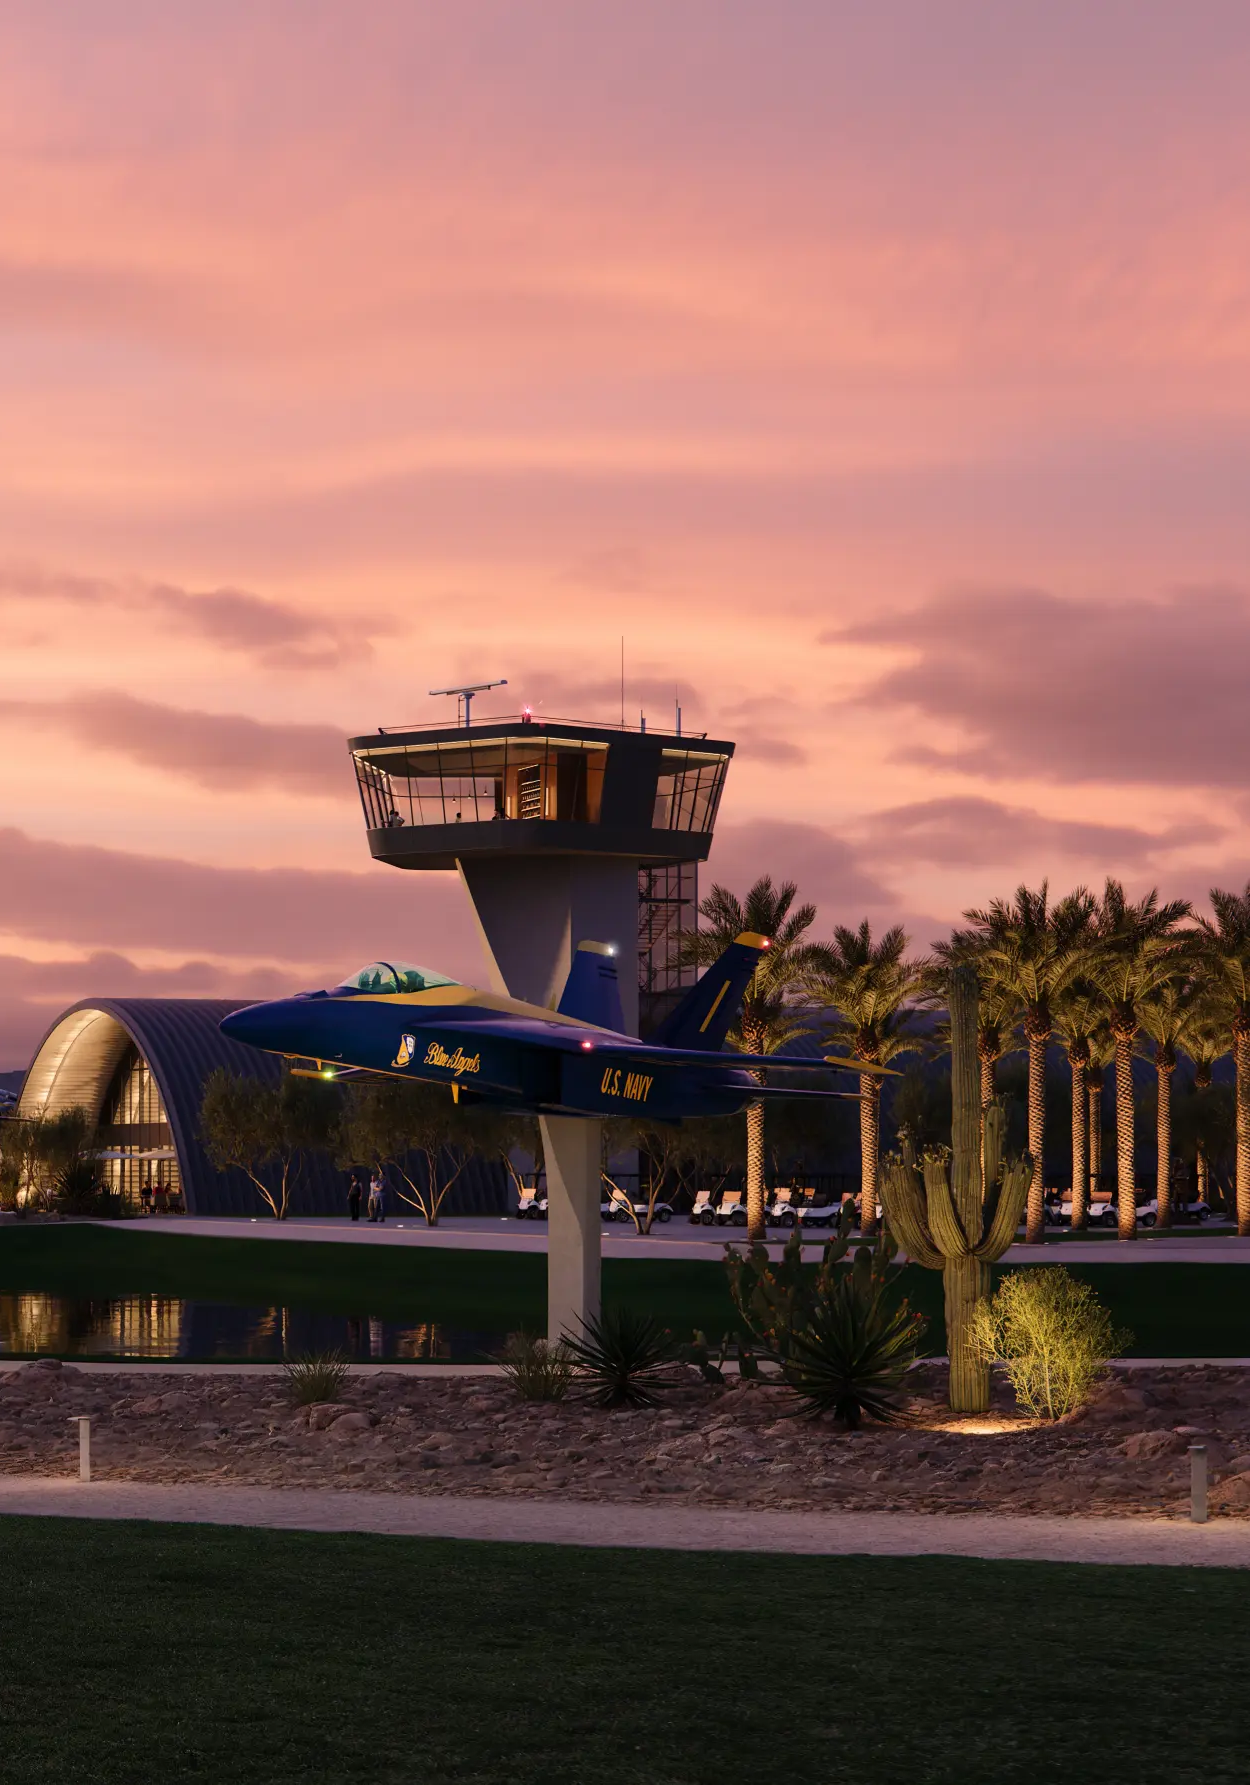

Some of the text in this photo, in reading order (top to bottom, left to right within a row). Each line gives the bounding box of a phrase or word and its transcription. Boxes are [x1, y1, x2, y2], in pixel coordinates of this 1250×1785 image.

[423, 1041, 481, 1077] Blue Angels
[600, 1067, 654, 1102] U.S. NAVY
